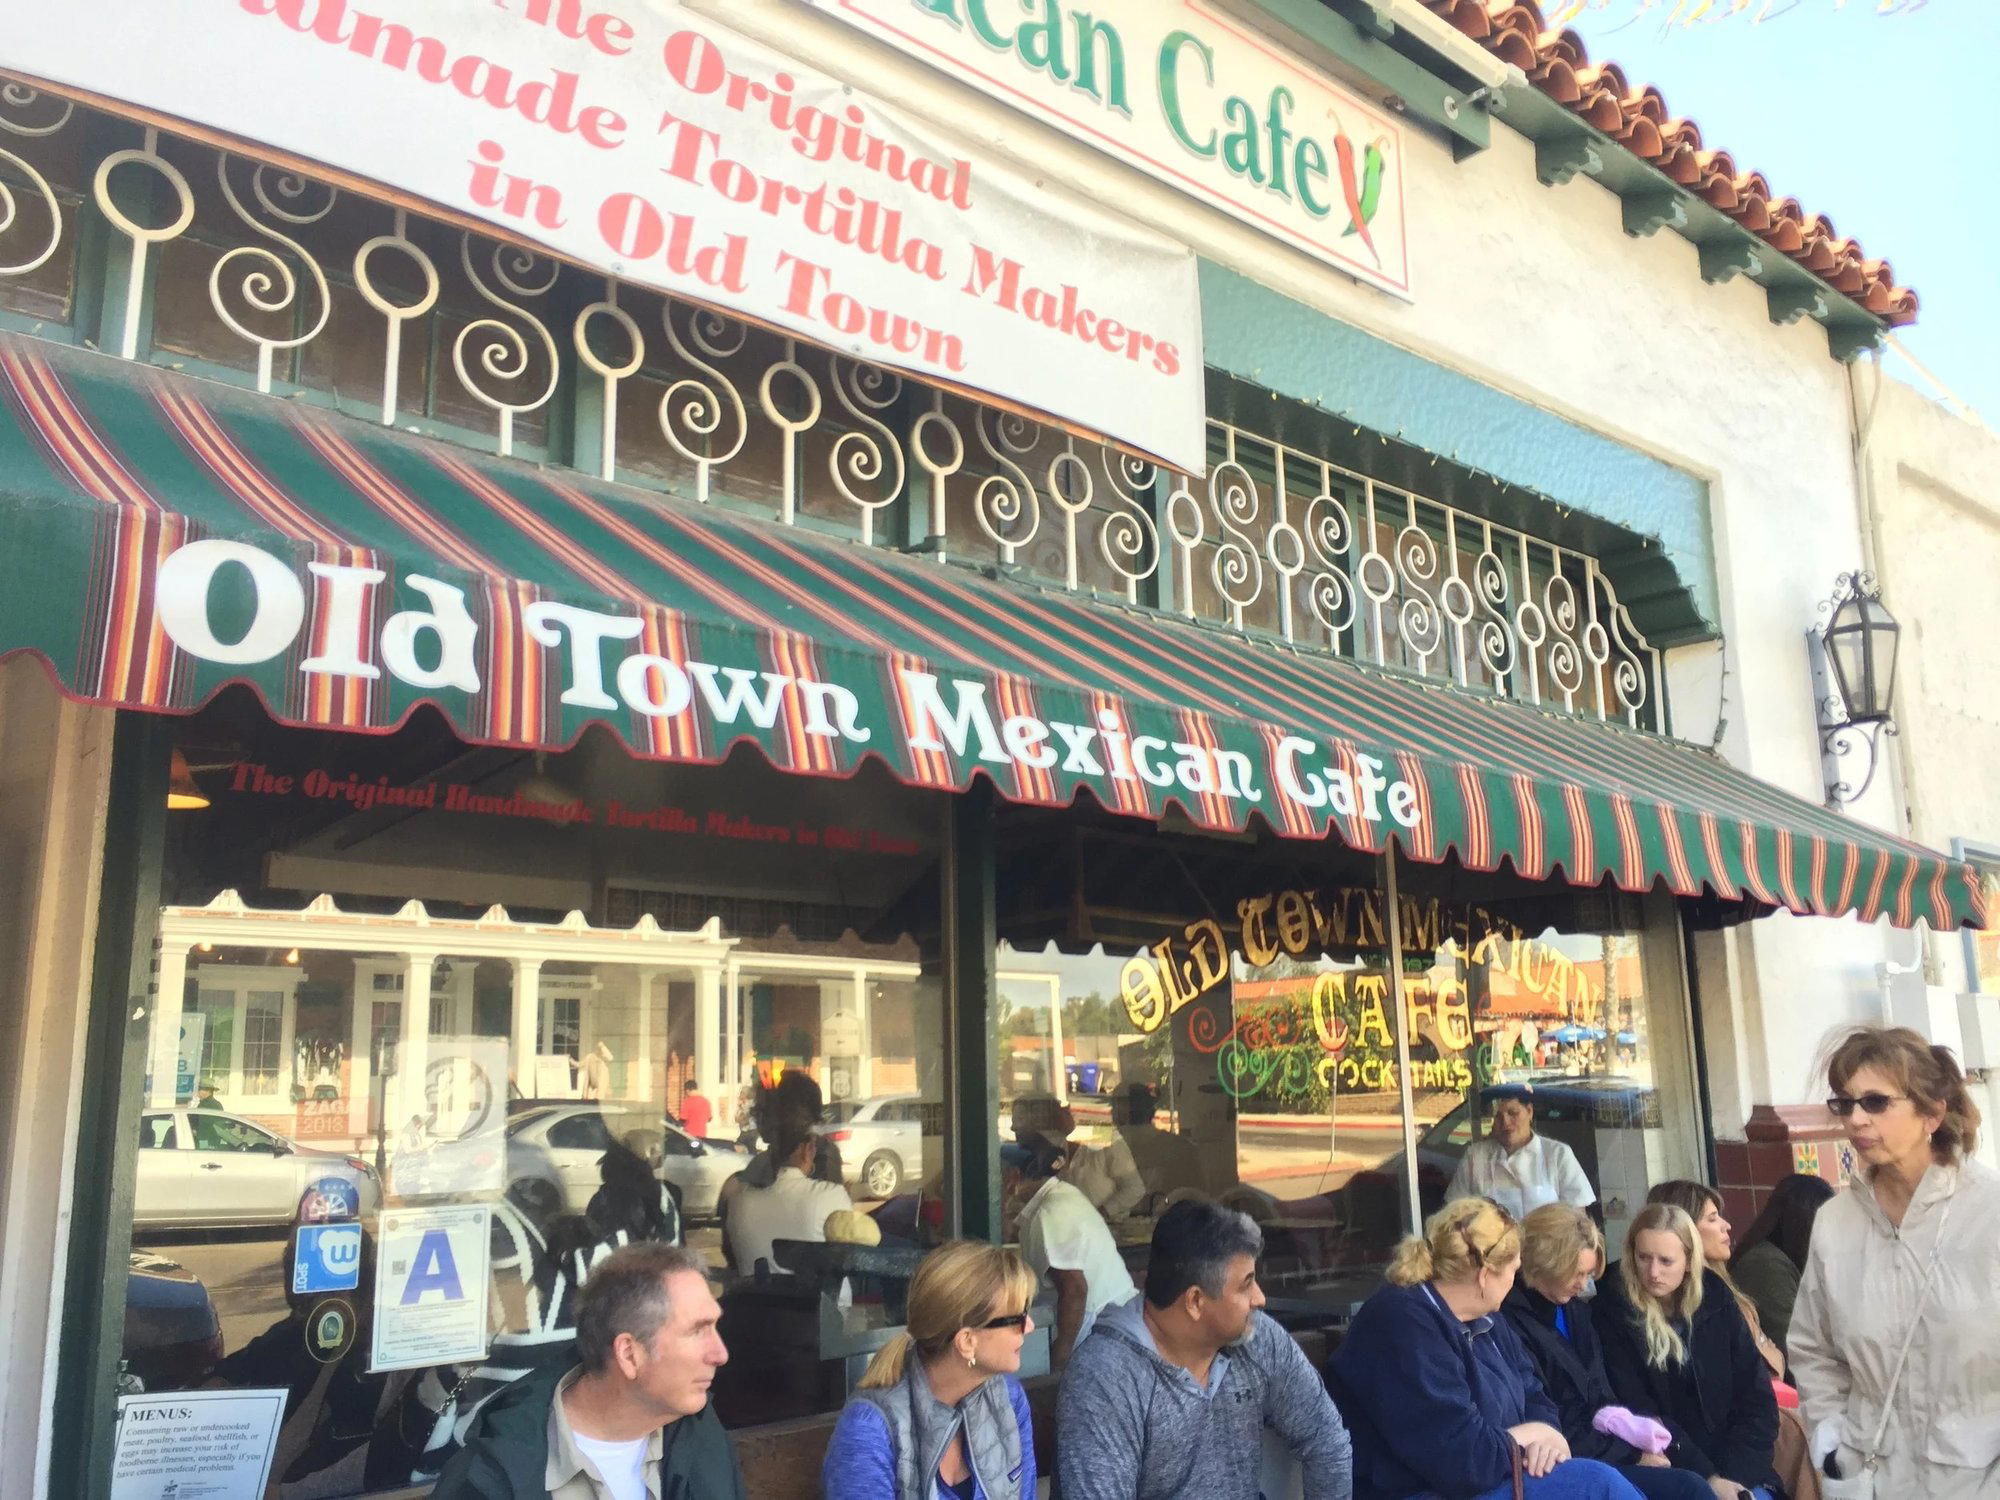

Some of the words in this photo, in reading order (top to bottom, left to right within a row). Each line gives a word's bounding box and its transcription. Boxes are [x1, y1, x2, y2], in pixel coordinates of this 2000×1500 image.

[239, 0, 626, 149] dmade
[658, 112, 946, 281] Tortilla
[970, 243, 1180, 377] Makers
[663, 31, 972, 211] Original
[1157, 31, 1332, 218] Cafe
[467, 140, 566, 229] in
[597, 192, 747, 293] Old
[774, 248, 967, 372] Town
[156, 538, 482, 694] Old
[523, 600, 870, 742] Town
[905, 670, 1263, 802] Mexican
[1276, 736, 1422, 828] Cafe
[229, 762, 293, 795] The
[304, 769, 436, 812] Original
[1120, 918, 1229, 1031] OLD
[1237, 887, 1387, 967] TOWN
[1312, 972, 1474, 1051] CAFE
[296, 1262, 309, 1291] SPOT
[400, 1228, 464, 1305] A
[130, 1408, 193, 1422] MENUS:
